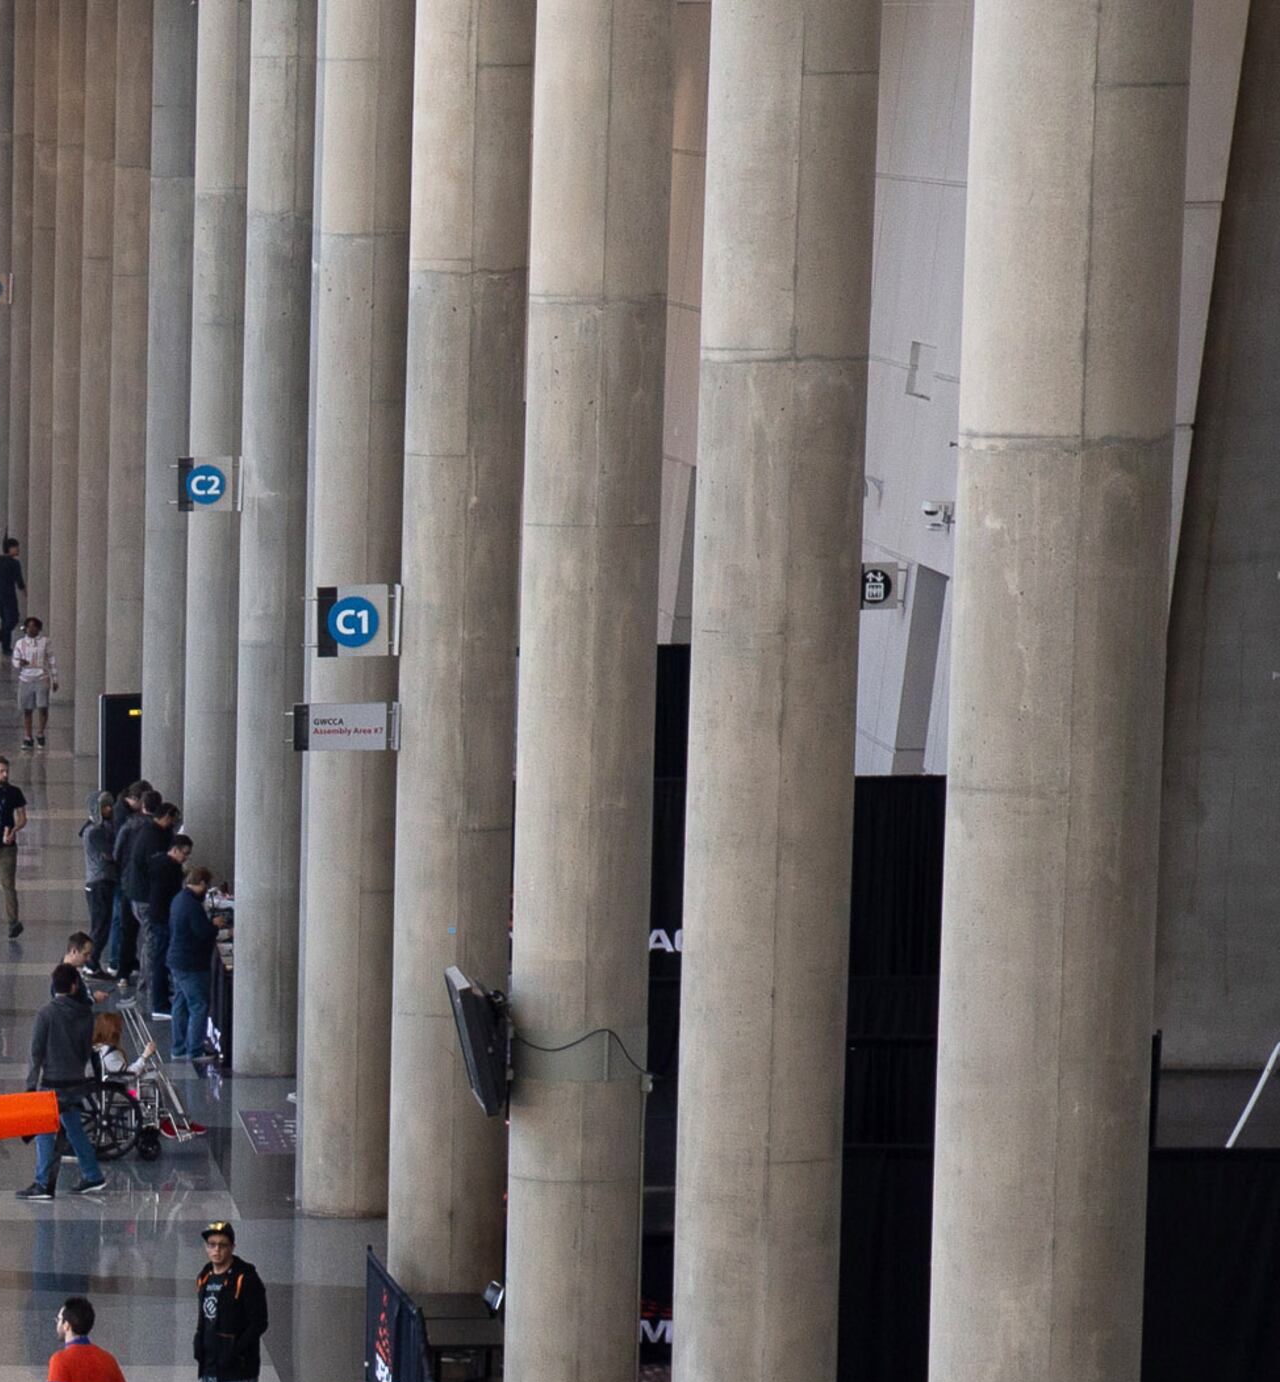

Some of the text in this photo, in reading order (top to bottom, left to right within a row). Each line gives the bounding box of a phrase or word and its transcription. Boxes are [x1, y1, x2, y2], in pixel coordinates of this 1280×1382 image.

[190, 475, 221, 496] C2
[336, 609, 369, 635] C1
[313, 718, 344, 726] GWCCA
[313, 727, 352, 736] Assembly
[353, 727, 372, 735] Area
